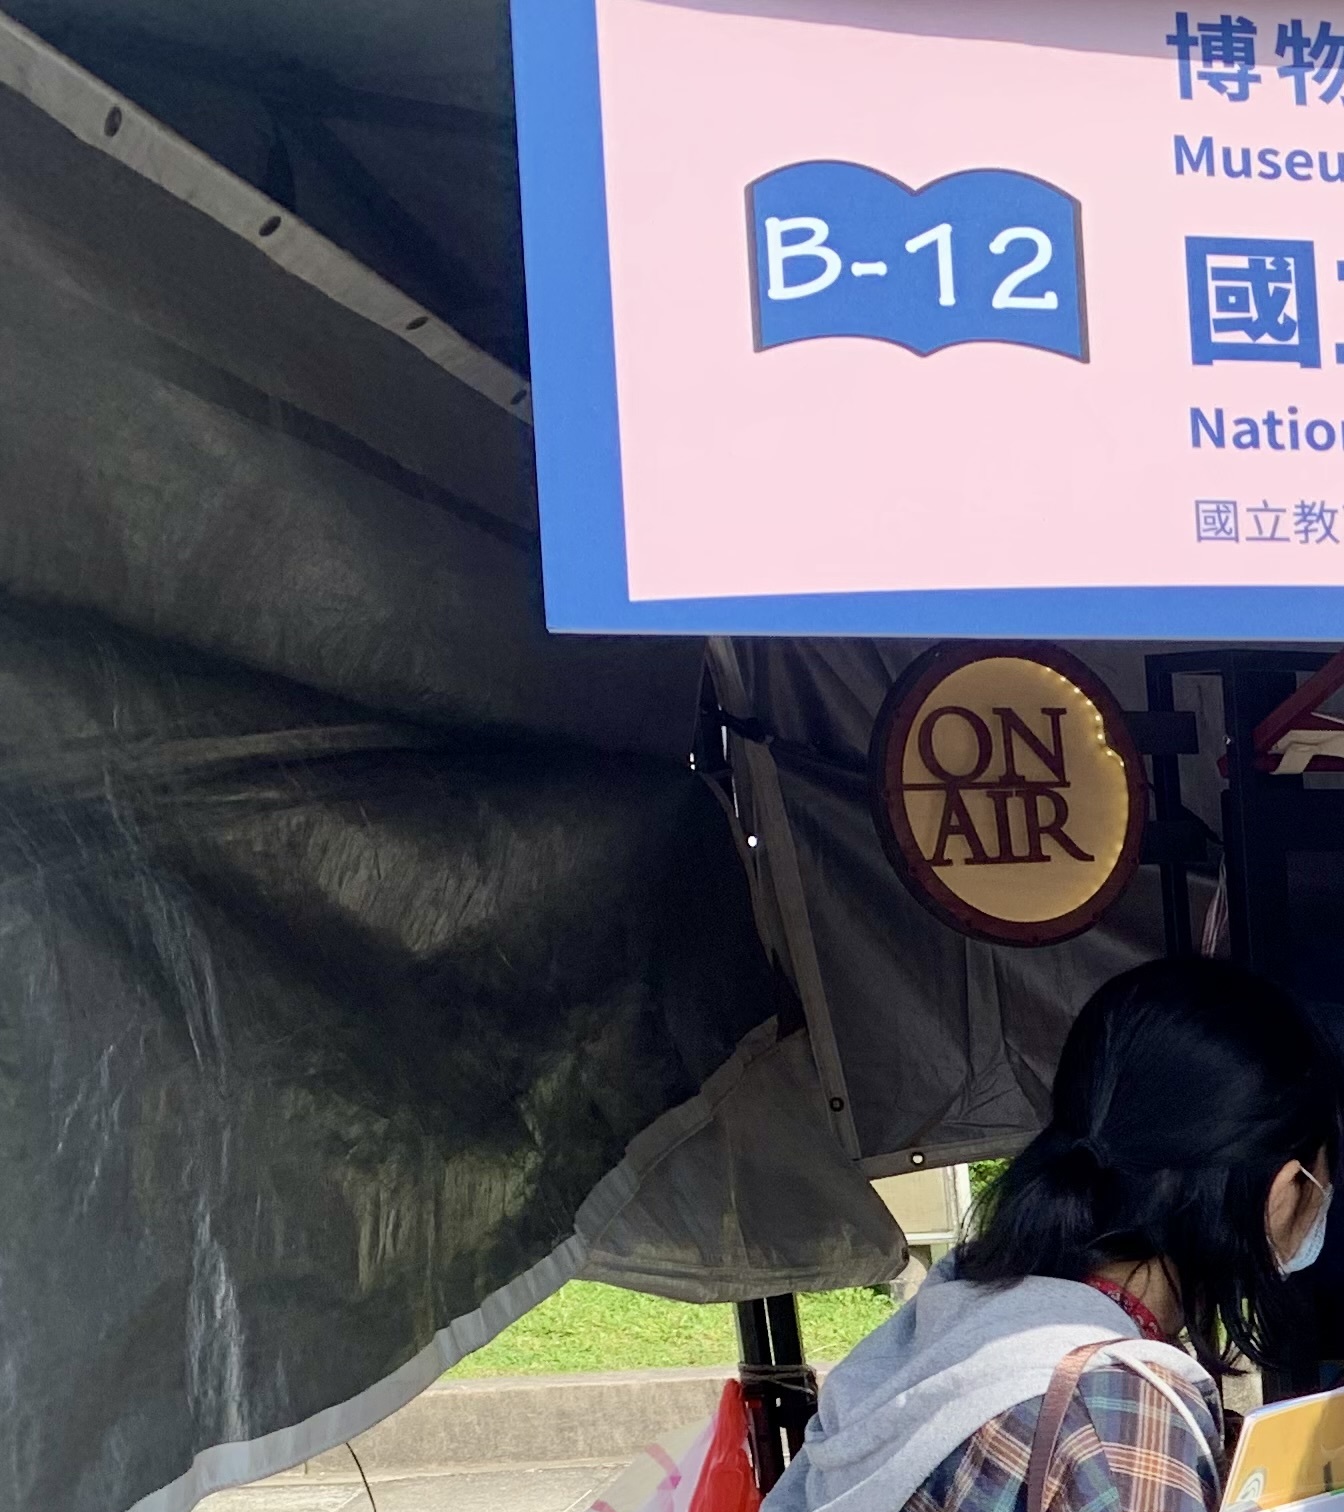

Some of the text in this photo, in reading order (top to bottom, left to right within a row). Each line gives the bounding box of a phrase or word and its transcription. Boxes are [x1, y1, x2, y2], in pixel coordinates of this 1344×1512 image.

[765, 216, 1059, 311] B-12
[917, 705, 1071, 788] ON
[924, 786, 1095, 867] AIR
